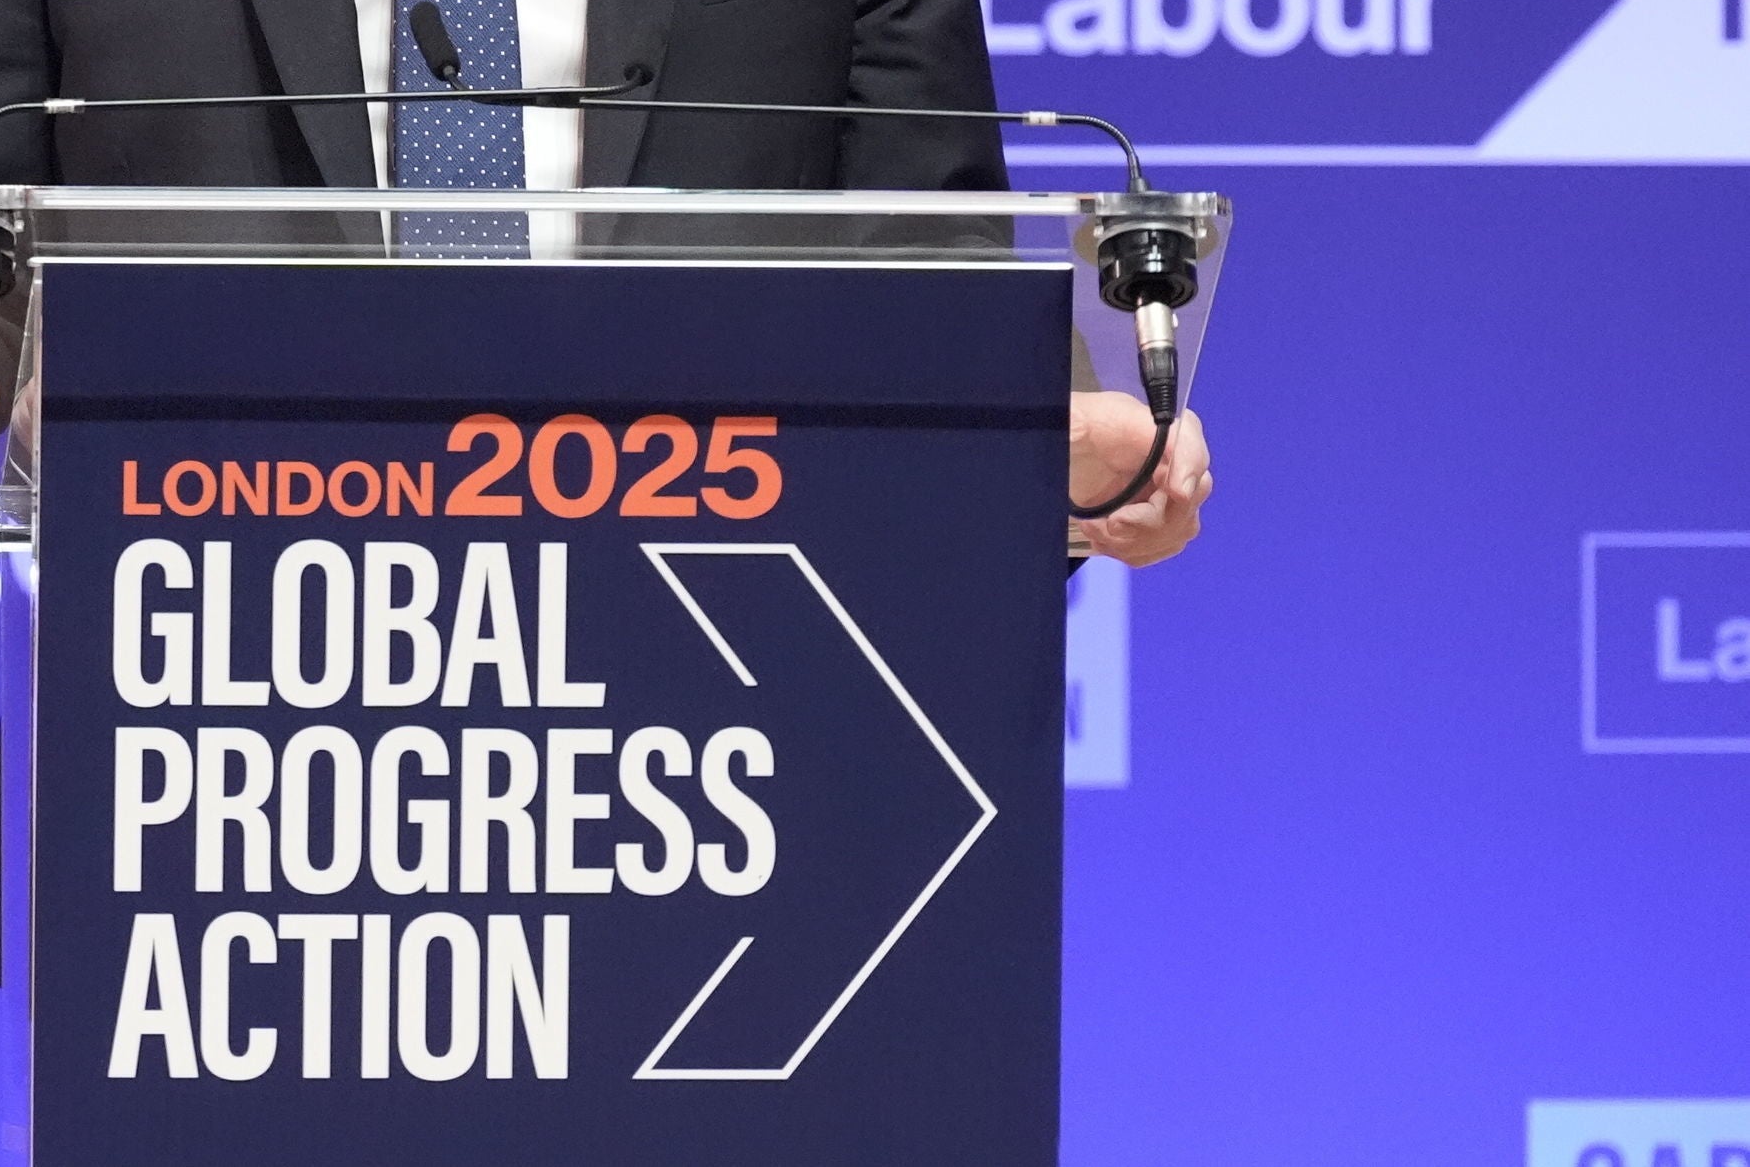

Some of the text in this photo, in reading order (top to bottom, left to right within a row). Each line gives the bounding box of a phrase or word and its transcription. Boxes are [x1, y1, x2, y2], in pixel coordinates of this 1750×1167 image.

[121, 413, 784, 520] LONDON 2025
[112, 537, 607, 710] GLOBAL
[113, 724, 777, 897] PROGRESS
[107, 911, 571, 1082] ACTION
